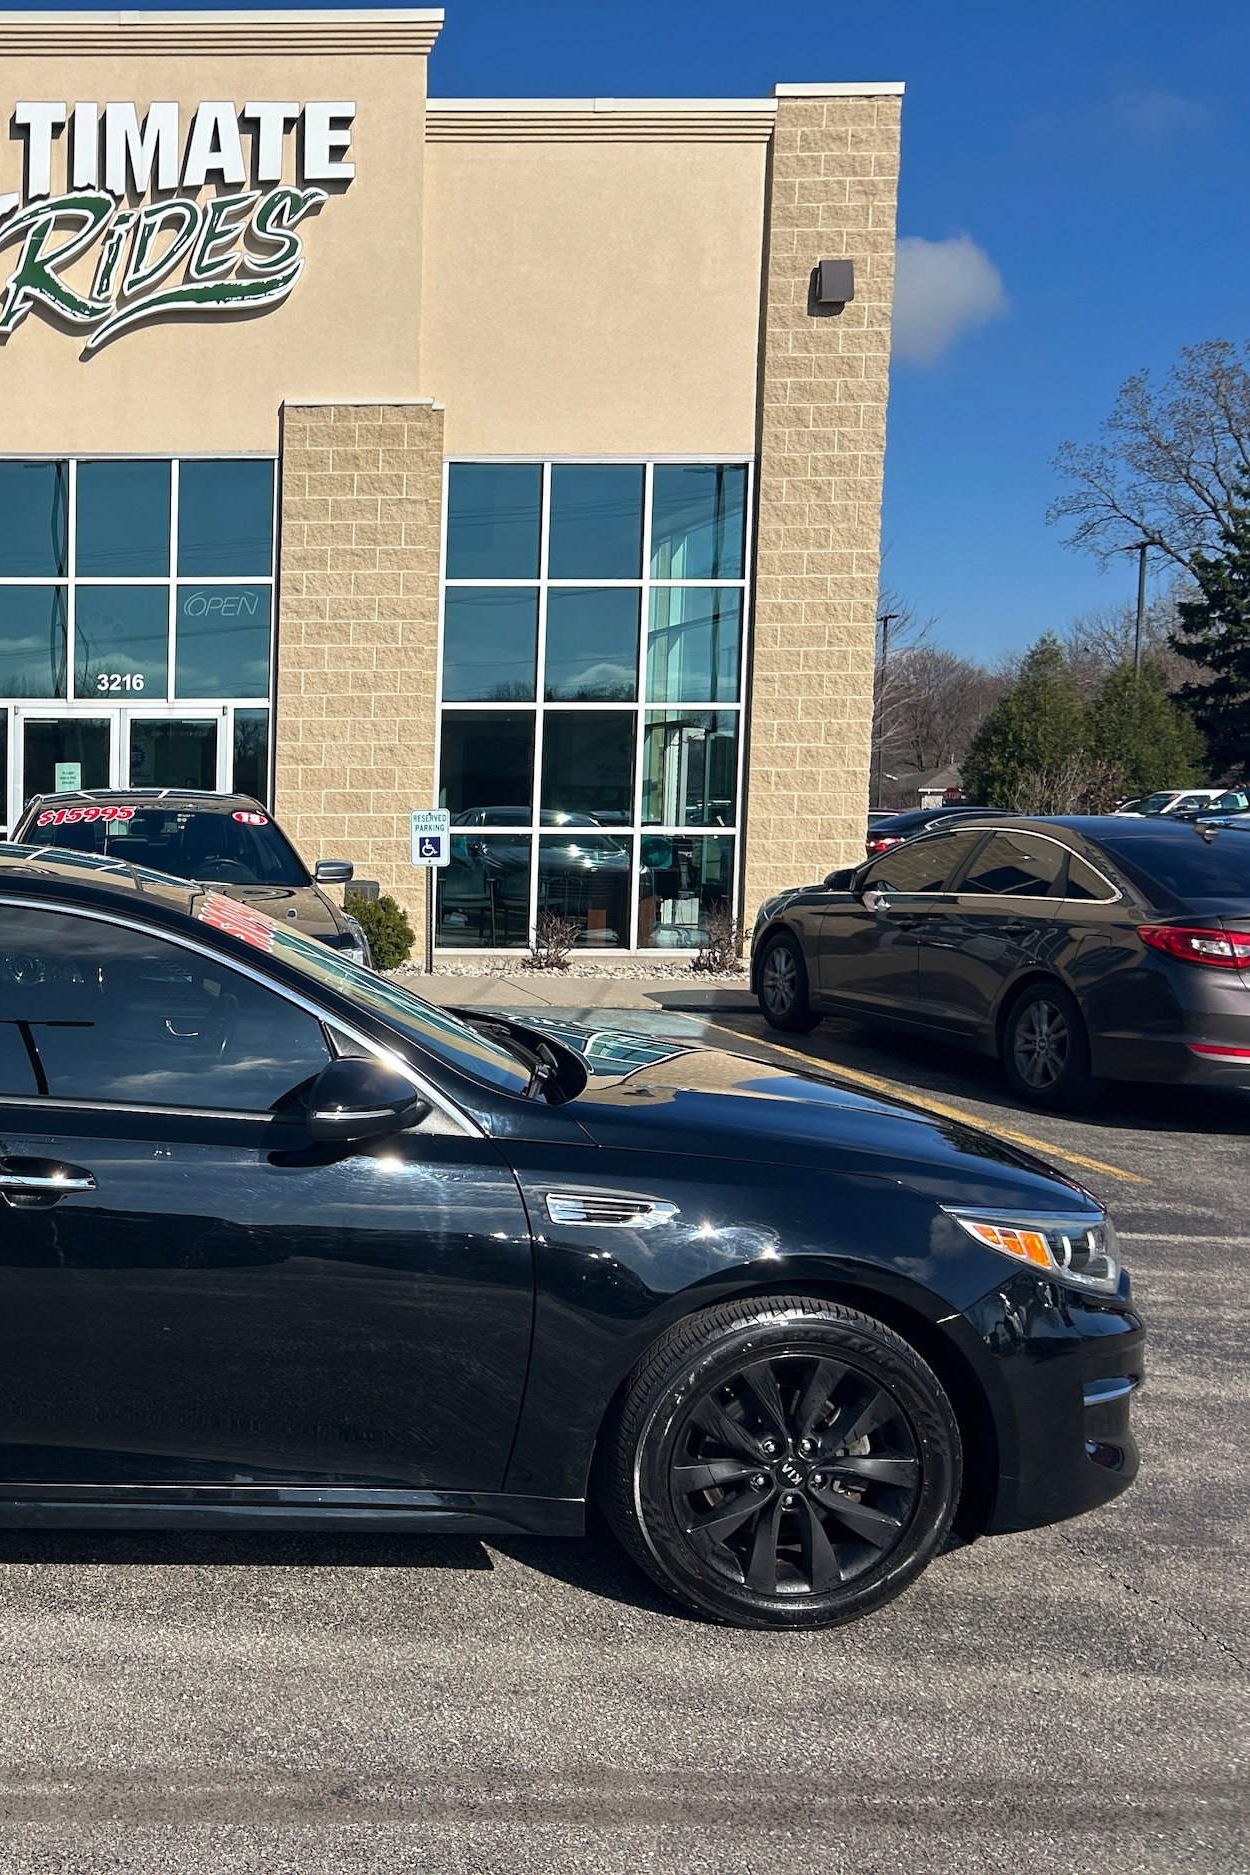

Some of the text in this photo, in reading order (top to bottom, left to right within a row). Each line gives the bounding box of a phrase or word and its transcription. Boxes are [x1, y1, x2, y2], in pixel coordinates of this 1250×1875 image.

[188, 596, 259, 616] OPEN
[97, 673, 144, 691] 3216
[943, 791, 961, 800] STOP
[37, 806, 137, 826] $15995
[413, 814, 447, 823] RESERVED
[415, 824, 445, 832] PARKING
[781, 1463, 803, 1485] KIA
